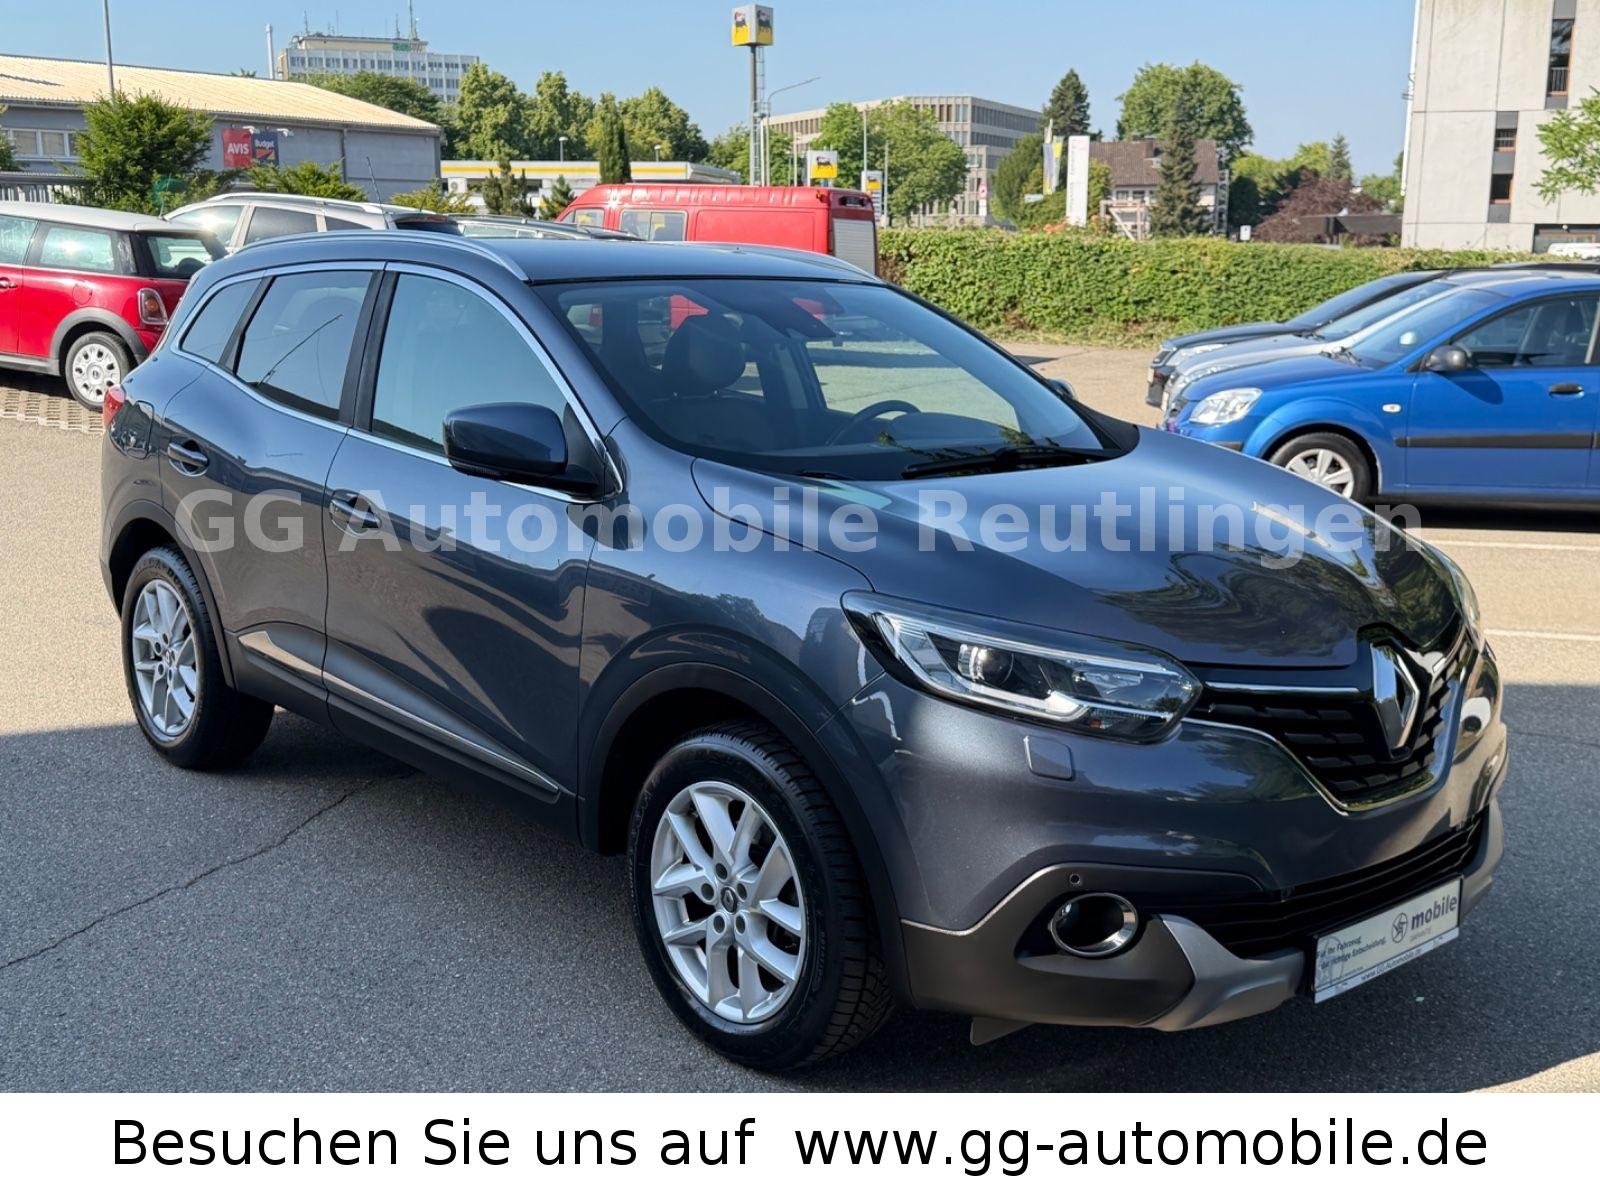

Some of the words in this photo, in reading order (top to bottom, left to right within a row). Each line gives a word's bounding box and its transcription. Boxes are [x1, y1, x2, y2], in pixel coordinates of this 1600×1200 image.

[227, 143, 250, 155] AVIS
[254, 139, 275, 150] Budget
[1410, 894, 1458, 931] mobile
